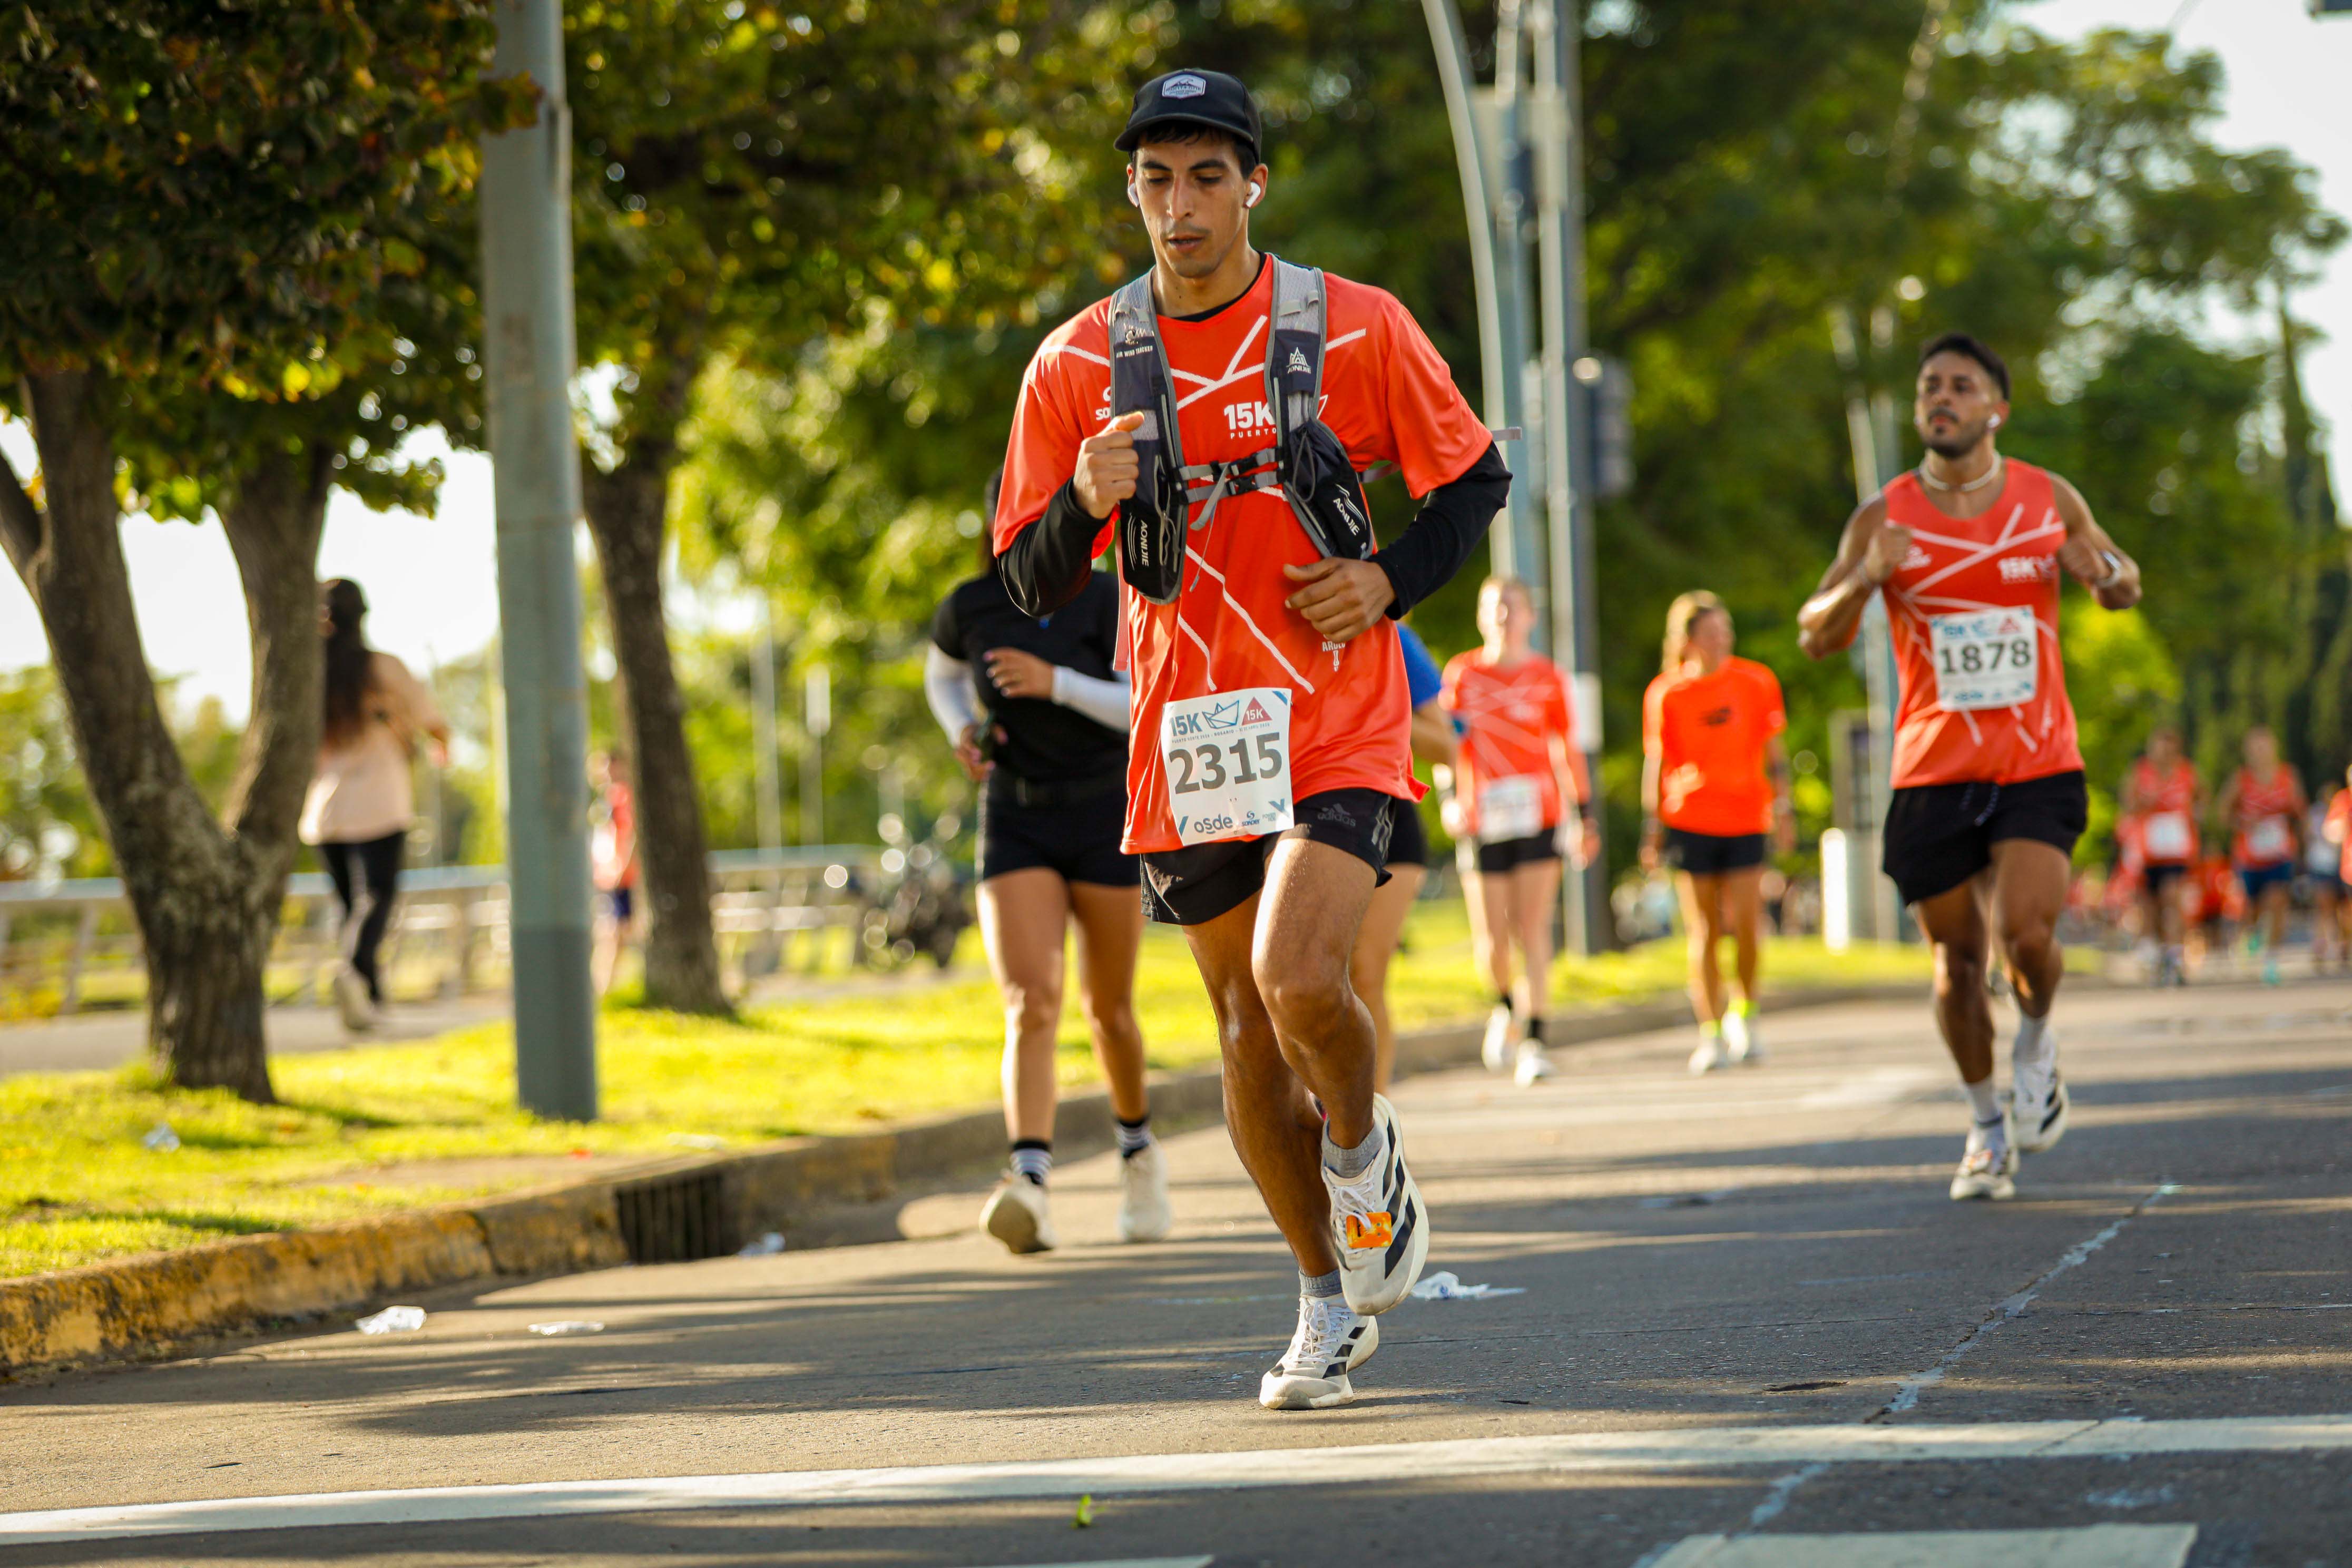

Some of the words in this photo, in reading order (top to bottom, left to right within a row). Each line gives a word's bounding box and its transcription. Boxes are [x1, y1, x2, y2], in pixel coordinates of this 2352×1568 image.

[1124, 349, 1135, 358] WIND
[1223, 401, 1276, 430] 15K
[1230, 428, 1277, 439] PUERTO
[1333, 497, 1360, 536] AONIJIE
[1140, 519, 1149, 566] AONIJIE
[1939, 639, 2031, 674] 1878
[1170, 712, 1202, 736] 15K
[1246, 708, 1264, 721] 15K
[1168, 732, 1282, 795] 2315
[1194, 814, 1233, 834] osde
[1318, 809, 1356, 827] adidas
